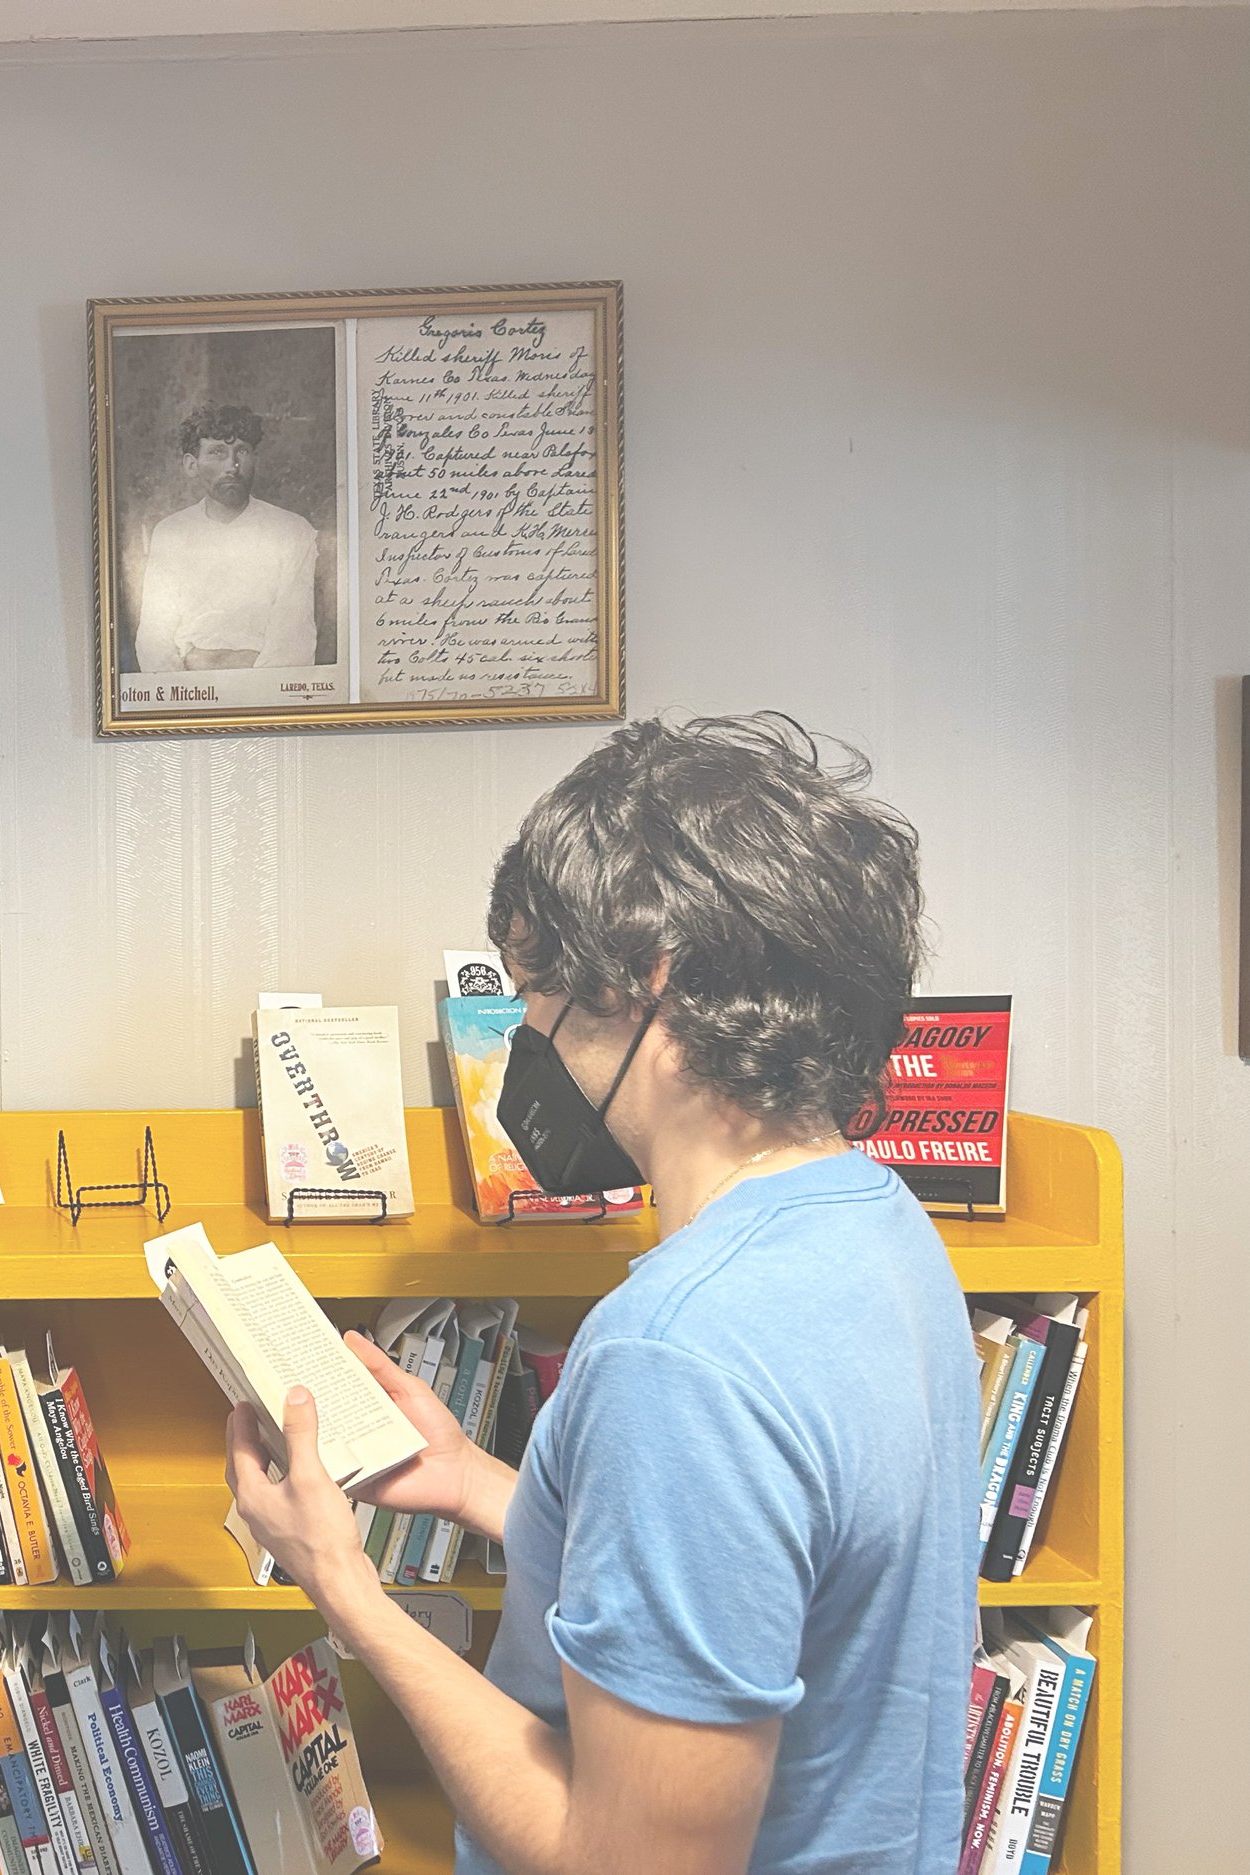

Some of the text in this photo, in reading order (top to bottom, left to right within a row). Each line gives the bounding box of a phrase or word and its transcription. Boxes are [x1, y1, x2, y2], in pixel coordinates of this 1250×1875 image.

[491, 317, 547, 347] Cortez
[375, 345, 502, 376] Killed sheriff
[375, 371, 435, 386] Karnes
[423, 444, 538, 467] Captured near
[428, 464, 548, 479] 50 miles above
[547, 499, 593, 516] State
[486, 572, 520, 582] was
[385, 607, 520, 627] miles the
[280, 682, 335, 691] LAREDO, TEXAS.
[409, 668, 455, 682] made
[155, 687, 165, 700] &
[170, 686, 218, 703] Mitchell,
[470, 966, 486, 976] 956
[889, 1054, 937, 1078] THE
[855, 1109, 1000, 1134] OPRESSED
[852, 1140, 992, 1162] PAULO FREIRE
[469, 1389, 483, 1420] KOZOL
[1008, 1391, 1028, 1422] KING
[5, 1424, 17, 1450] Sower
[46, 1401, 68, 1460] Maya Angelou
[1026, 1395, 1055, 1477] TACIT SUBJECTS
[56, 1403, 101, 1536] Know Caged Sings
[983, 1456, 1009, 1510] DRAGON
[1027, 1411, 1068, 1528] Drama Enough
[17, 1480, 40, 1561] OCTAVIA BUTLER
[74, 1676, 92, 1688] Clark
[271, 1646, 328, 1717] KARL
[37, 1706, 51, 1735] Nickel
[278, 1676, 344, 1764] MARX
[1050, 1676, 1084, 1784] MATCH ON DRY GRASS
[146, 1728, 172, 1781] KOZOL
[185, 1748, 207, 1763] NAOMI
[1010, 1668, 1060, 1818] BEAUTIFUL TROUBLE
[87, 1712, 123, 1822] Political Economy
[189, 1758, 211, 1771] KLEIN
[292, 1723, 347, 1793] CAPITAL
[28, 1739, 63, 1828] WHITE FRAGILITY
[190, 1766, 213, 1782] THIS
[1005, 1838, 1018, 1861] BOYD
